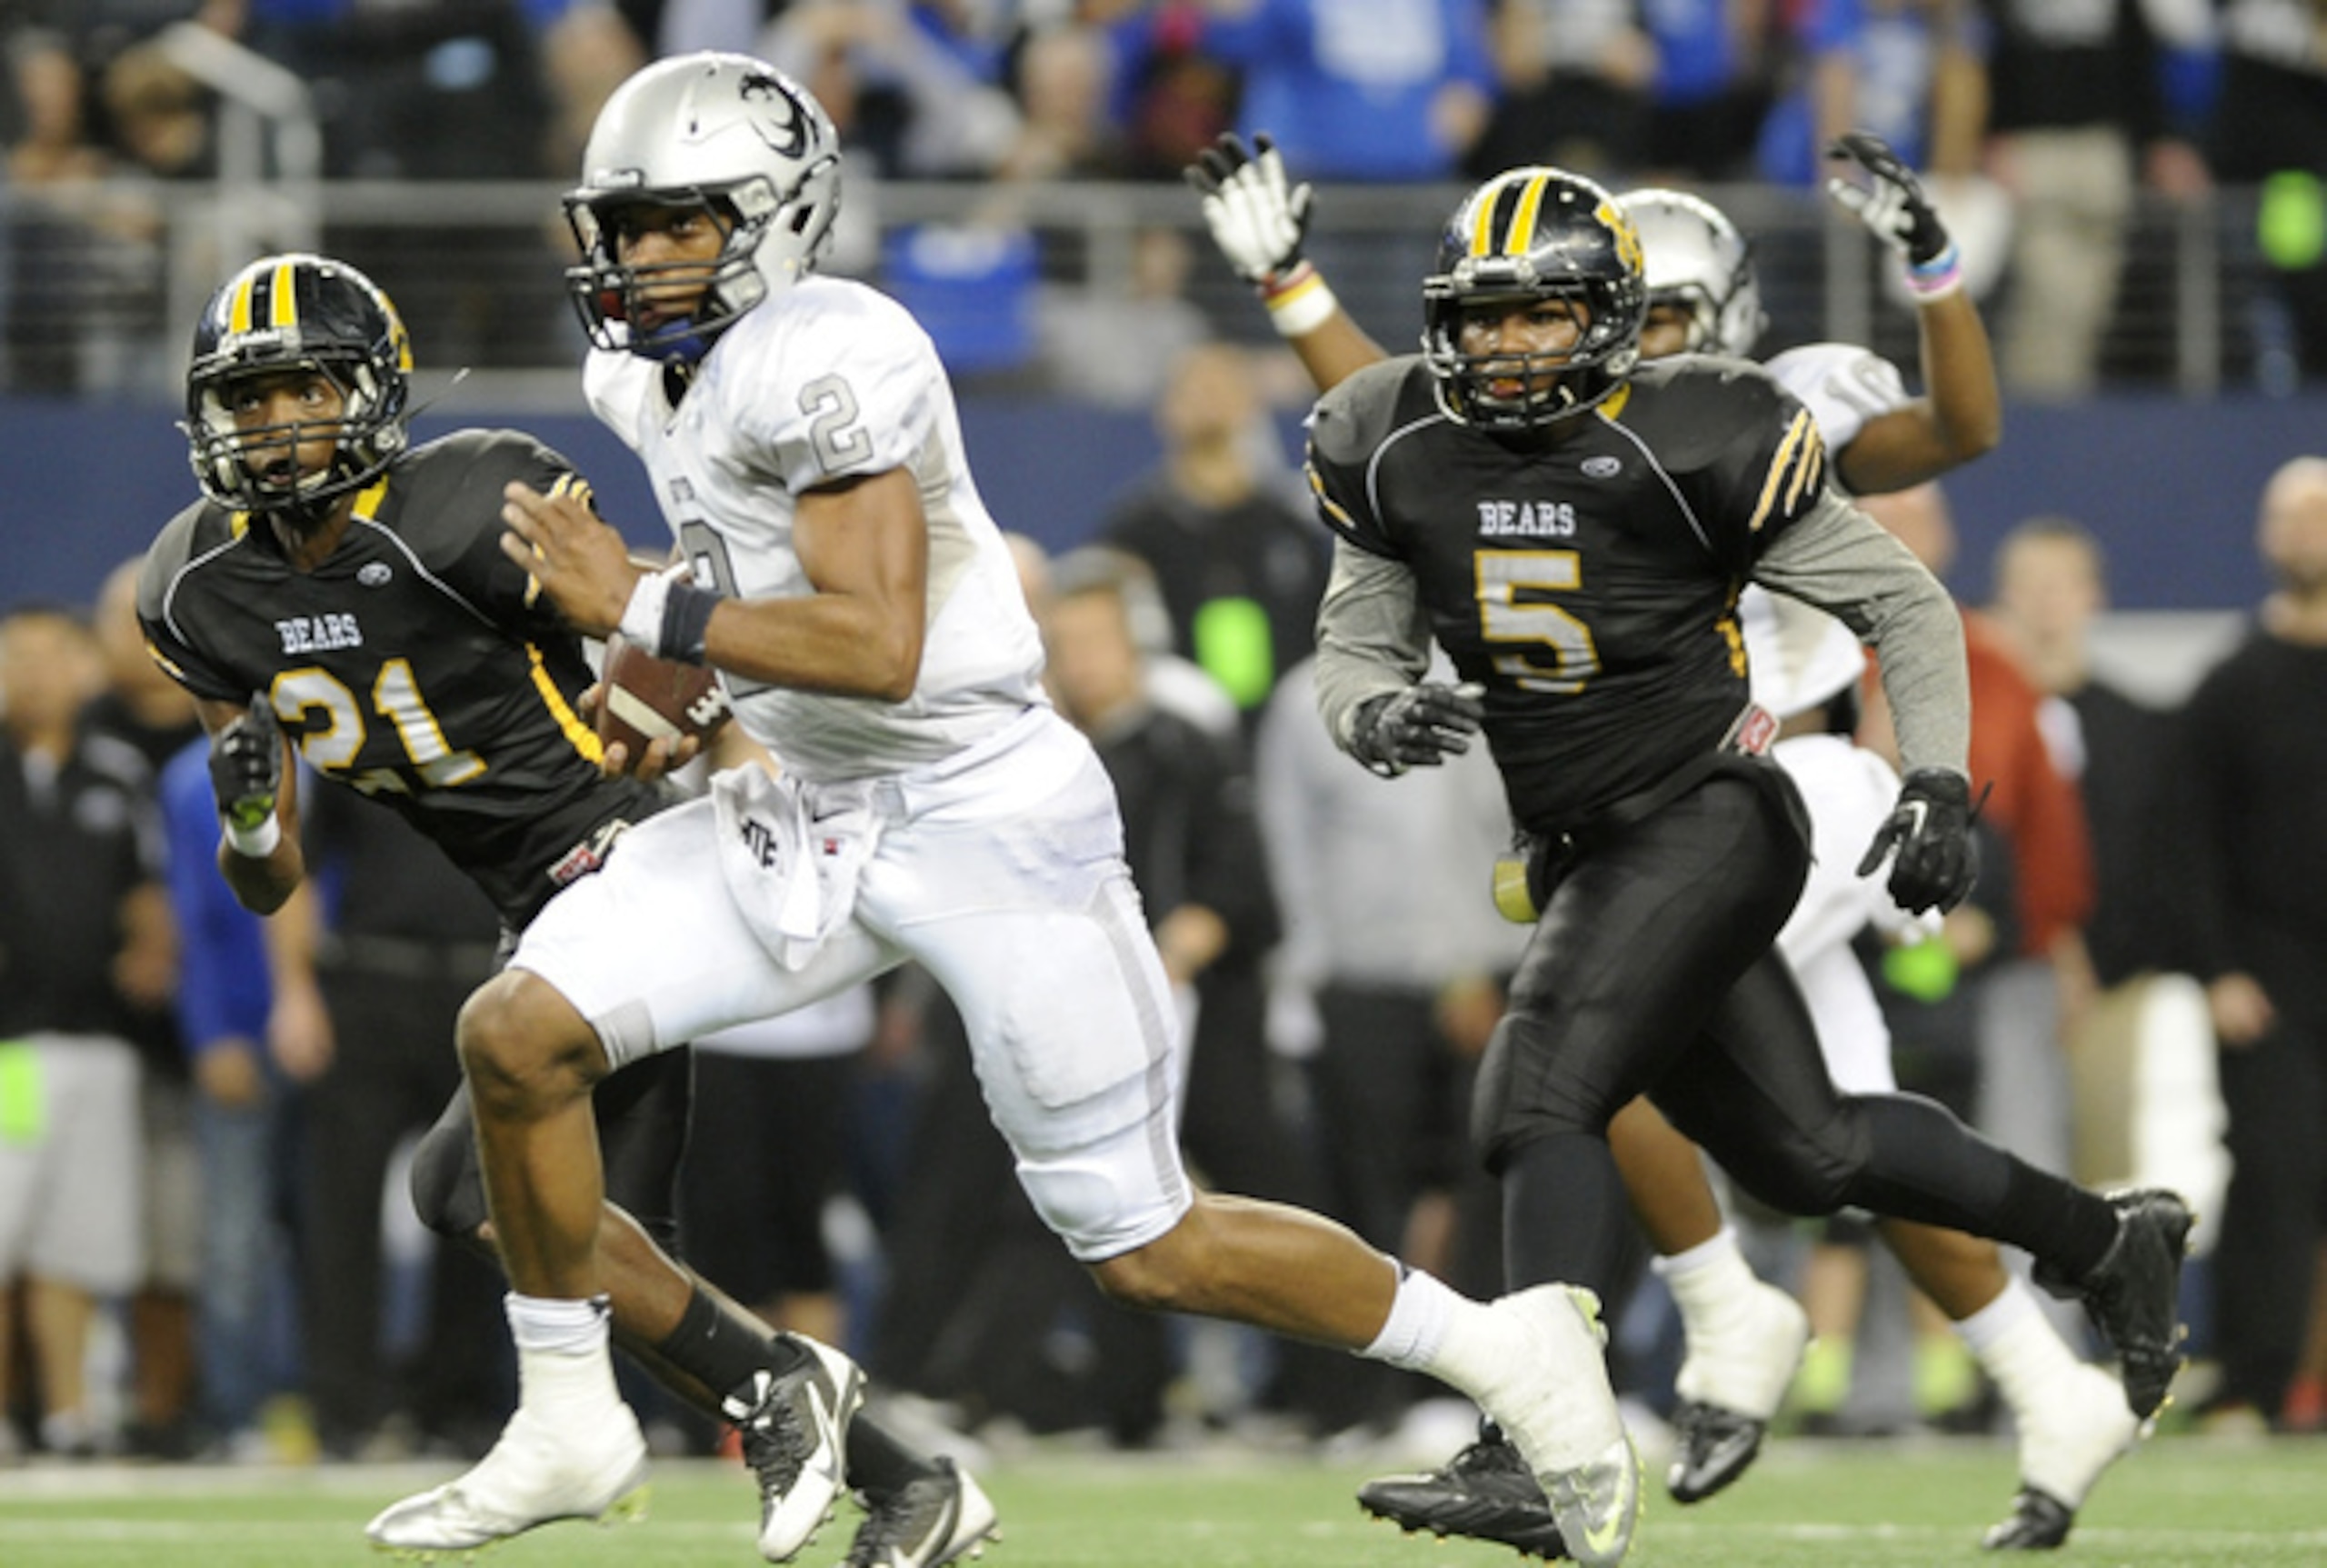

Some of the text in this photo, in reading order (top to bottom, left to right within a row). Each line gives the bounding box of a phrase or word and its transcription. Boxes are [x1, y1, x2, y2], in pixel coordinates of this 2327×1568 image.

[798, 372, 874, 474] 2
[1478, 503, 1577, 535] BEARS
[275, 614, 363, 654] BEARS
[1473, 549, 1603, 694] 5
[269, 657, 488, 796] 21
